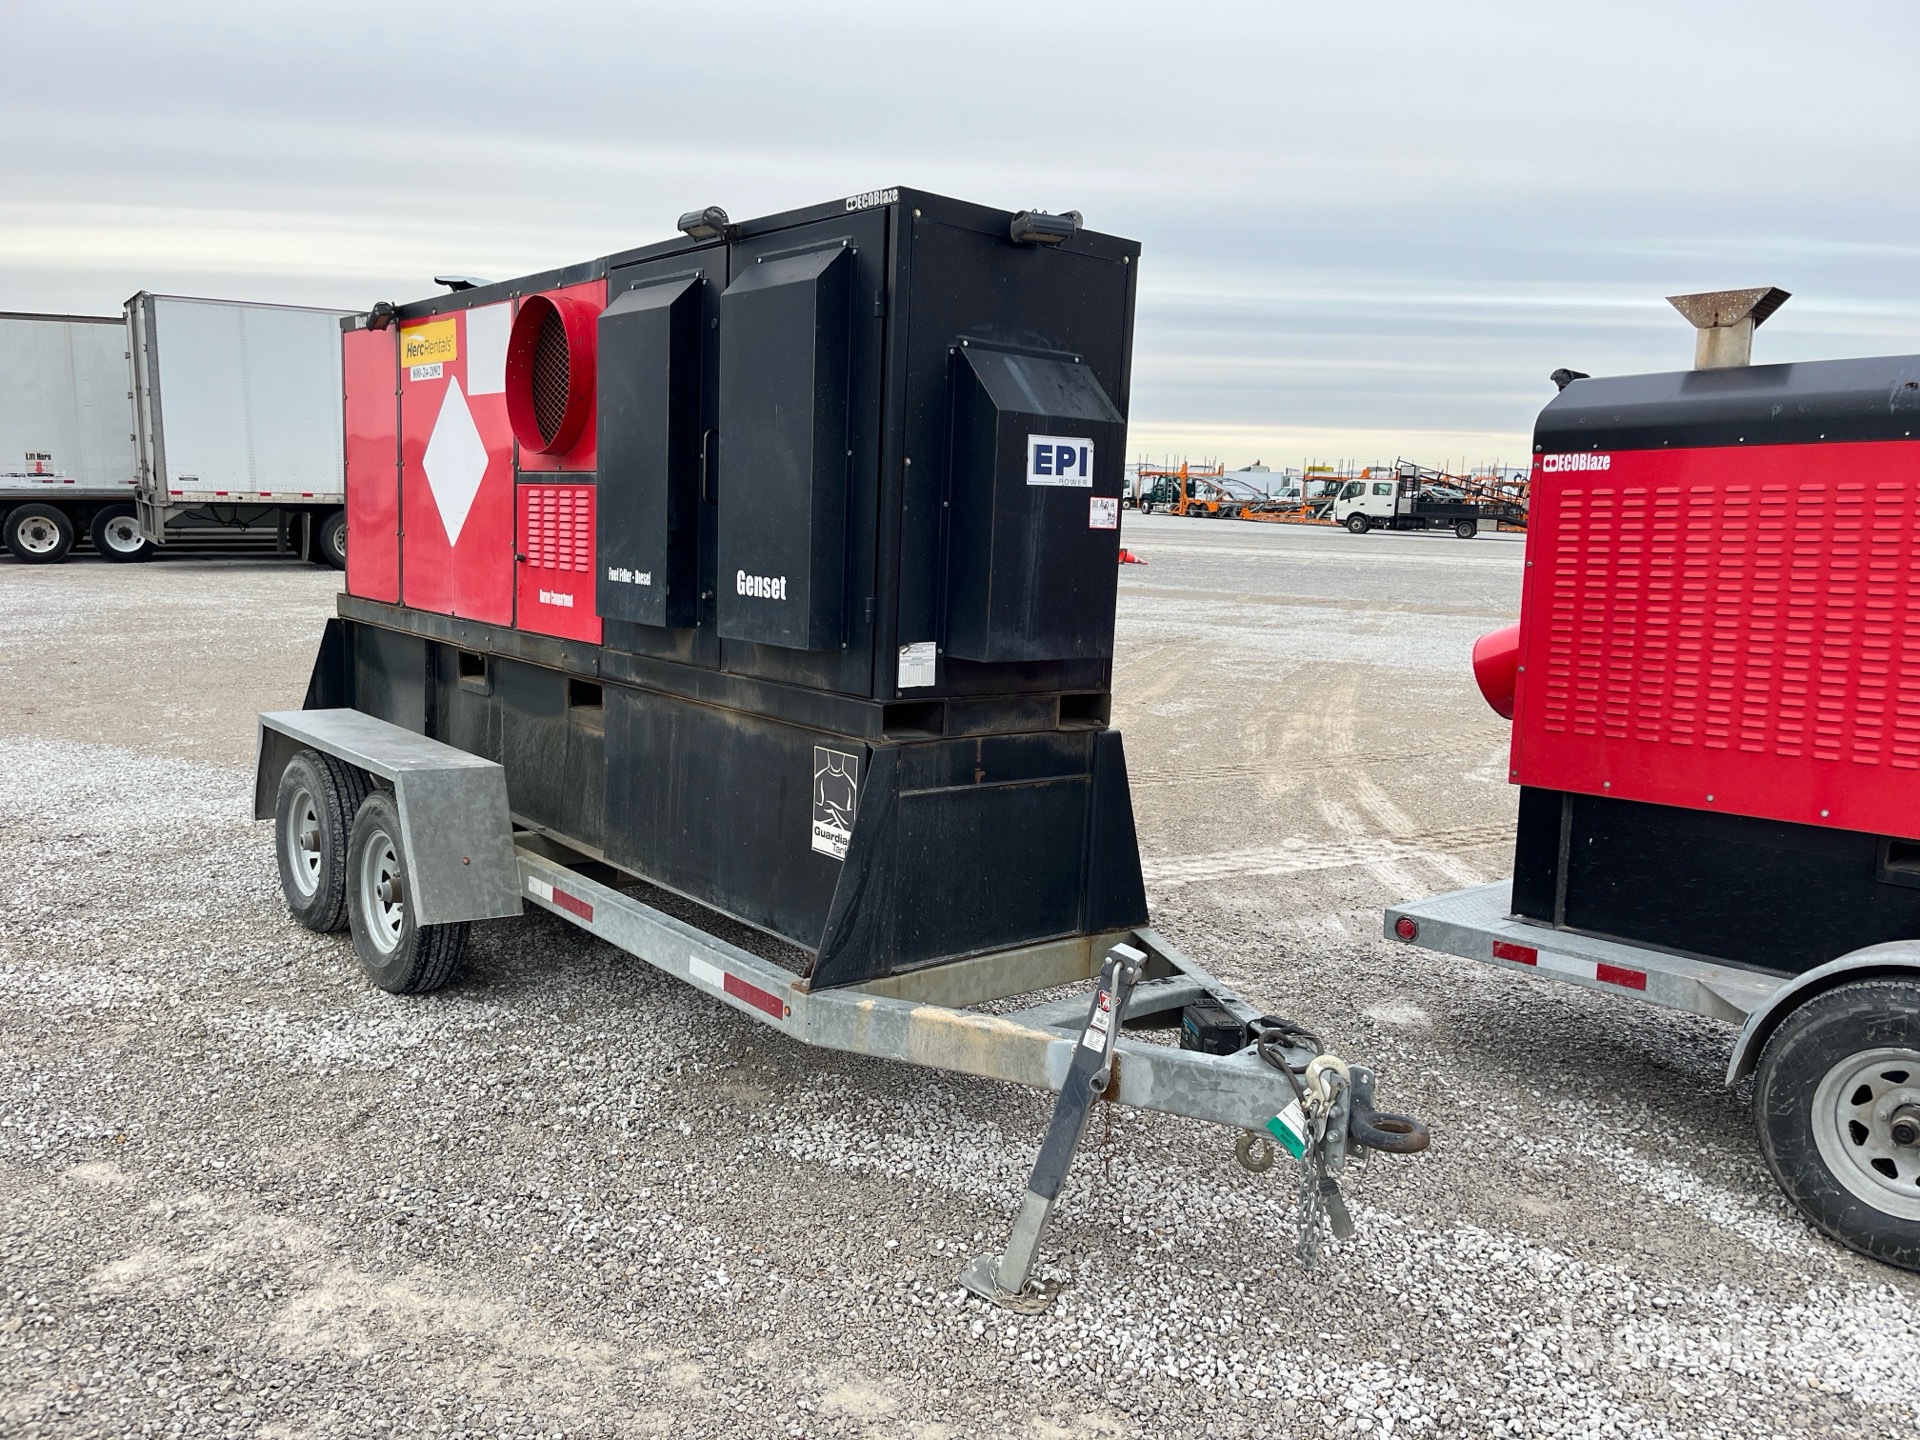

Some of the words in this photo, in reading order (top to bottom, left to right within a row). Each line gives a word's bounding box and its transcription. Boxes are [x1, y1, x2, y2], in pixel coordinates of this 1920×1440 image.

[857, 189, 898, 209] ECOBlaze
[1033, 444, 1087, 476] EPI
[1558, 453, 1610, 472] ECOBlaze
[1058, 479, 1088, 487] POWER
[736, 569, 787, 600] Genset
[814, 826, 848, 846] Guardia
